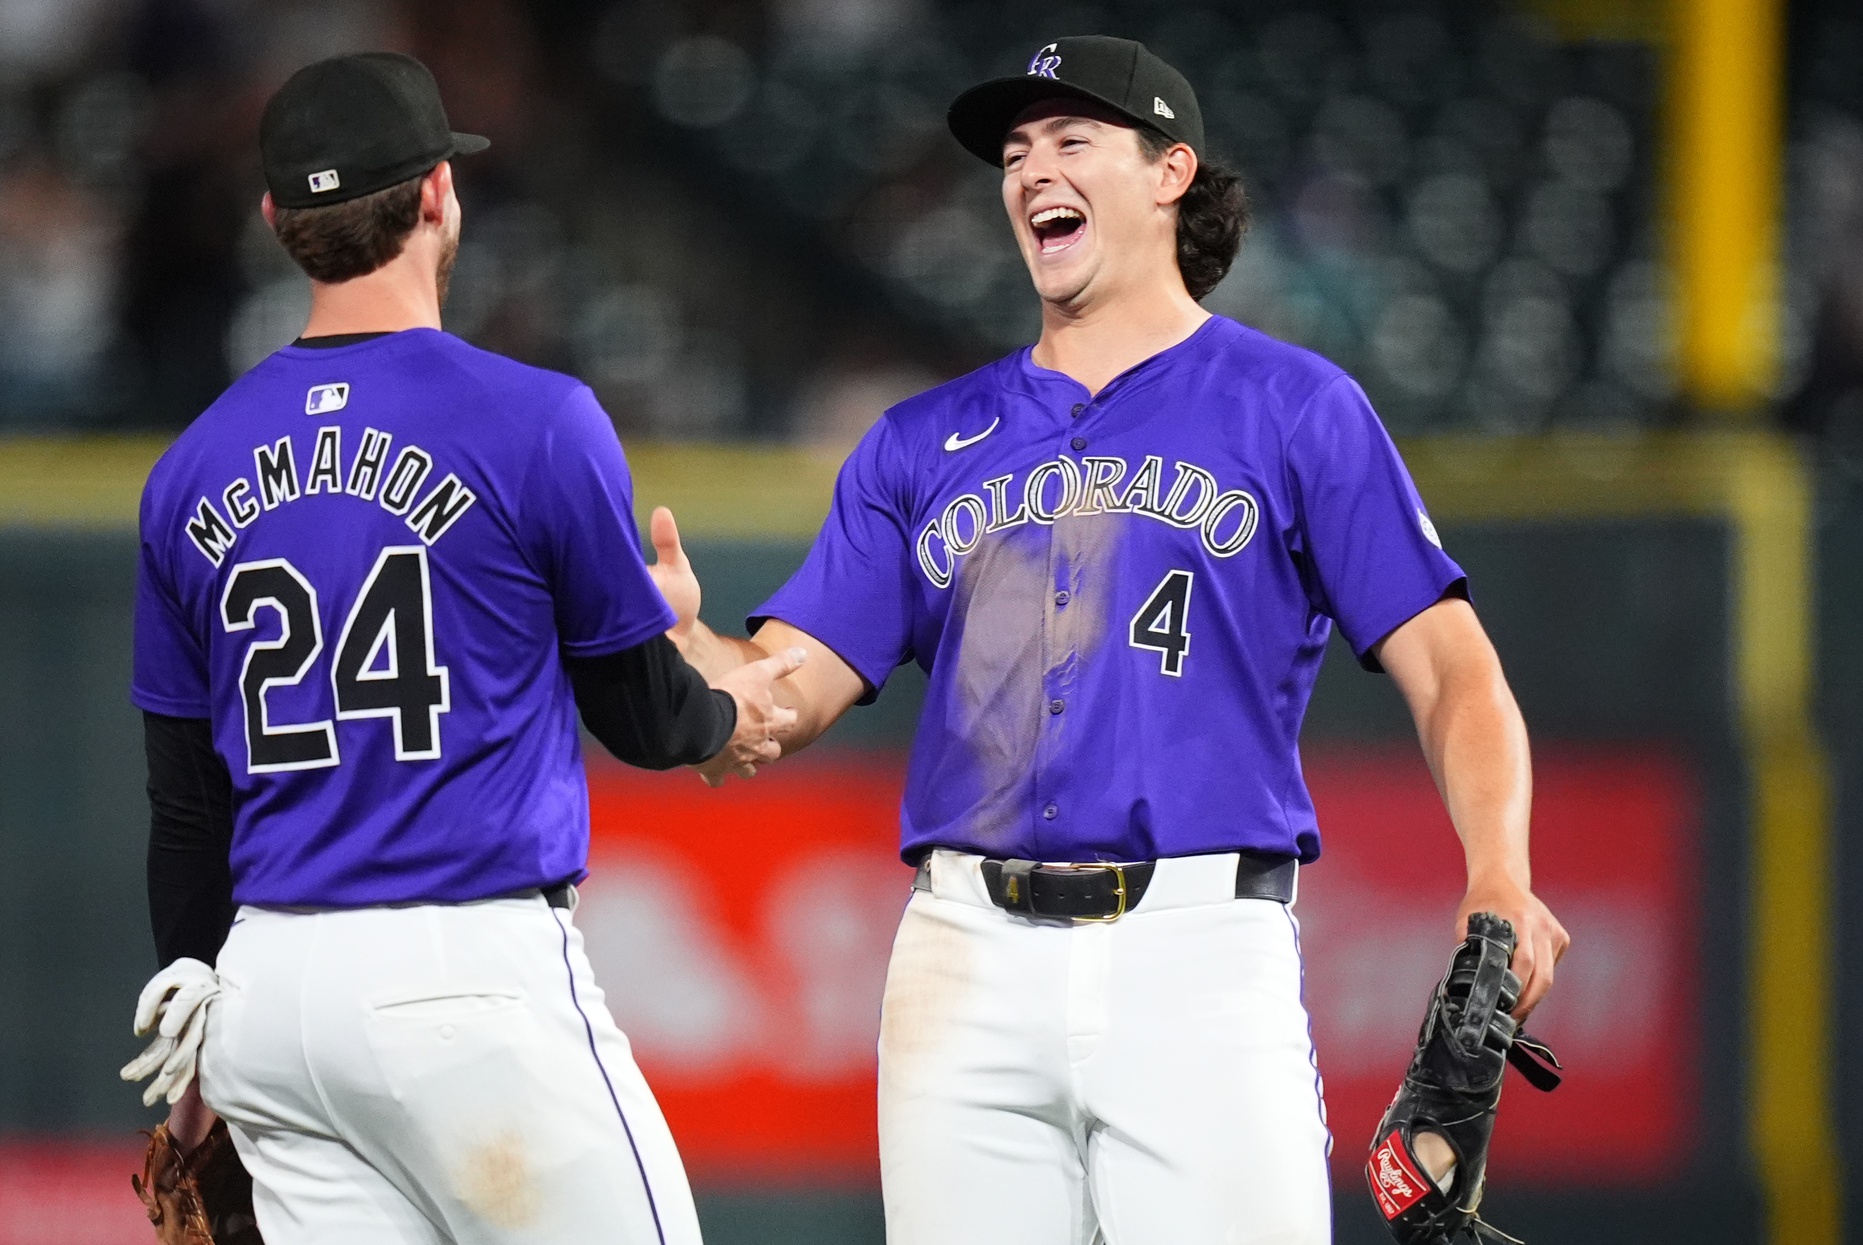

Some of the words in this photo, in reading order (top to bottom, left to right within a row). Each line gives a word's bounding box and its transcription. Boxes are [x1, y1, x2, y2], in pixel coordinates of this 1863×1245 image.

[916, 455, 1259, 588] COLORADO
[220, 545, 451, 775] 24
[1129, 569, 1194, 677] 4
[1377, 1149, 1412, 1197] Rawlings
